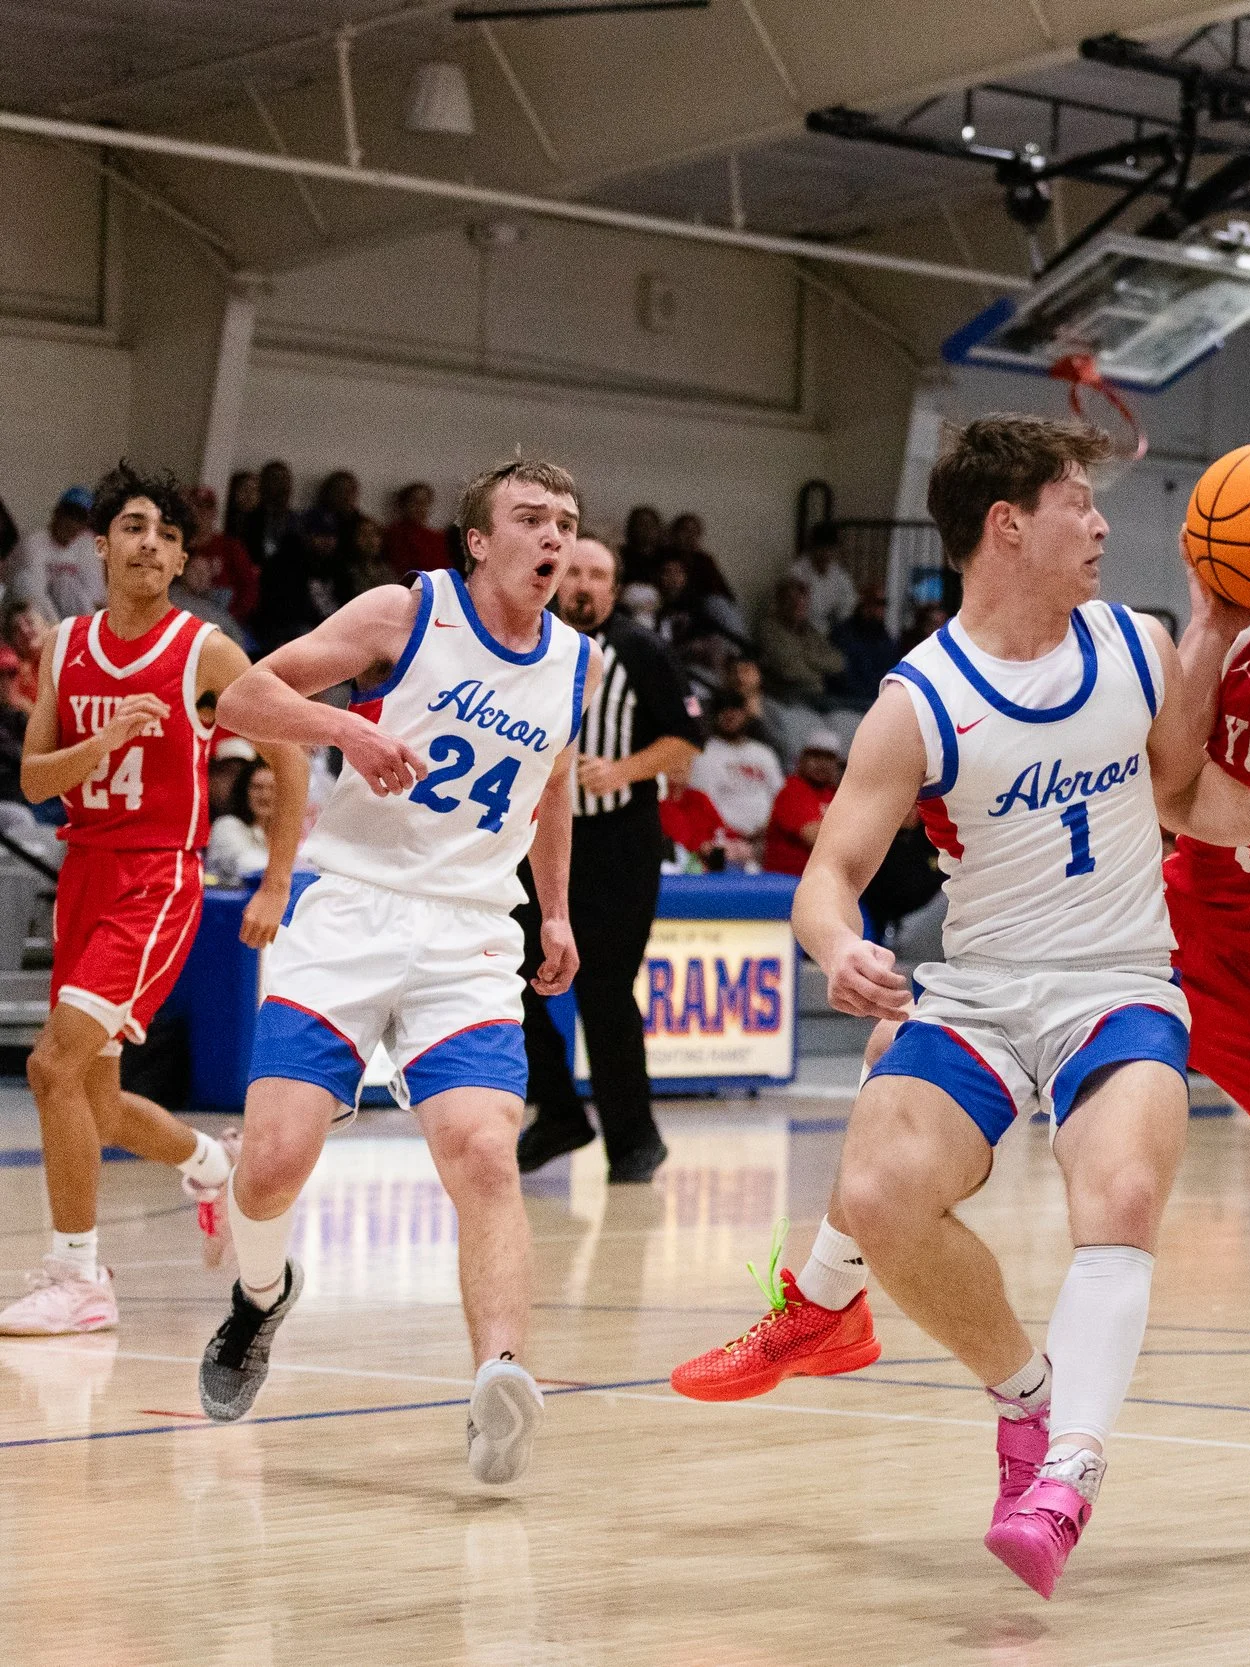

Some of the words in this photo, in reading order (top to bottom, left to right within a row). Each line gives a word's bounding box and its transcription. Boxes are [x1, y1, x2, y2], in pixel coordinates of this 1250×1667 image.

[428, 680, 549, 752] Akron
[408, 734, 521, 834] 24
[1060, 801, 1096, 878] 1
[643, 957, 782, 1034] RAMS
